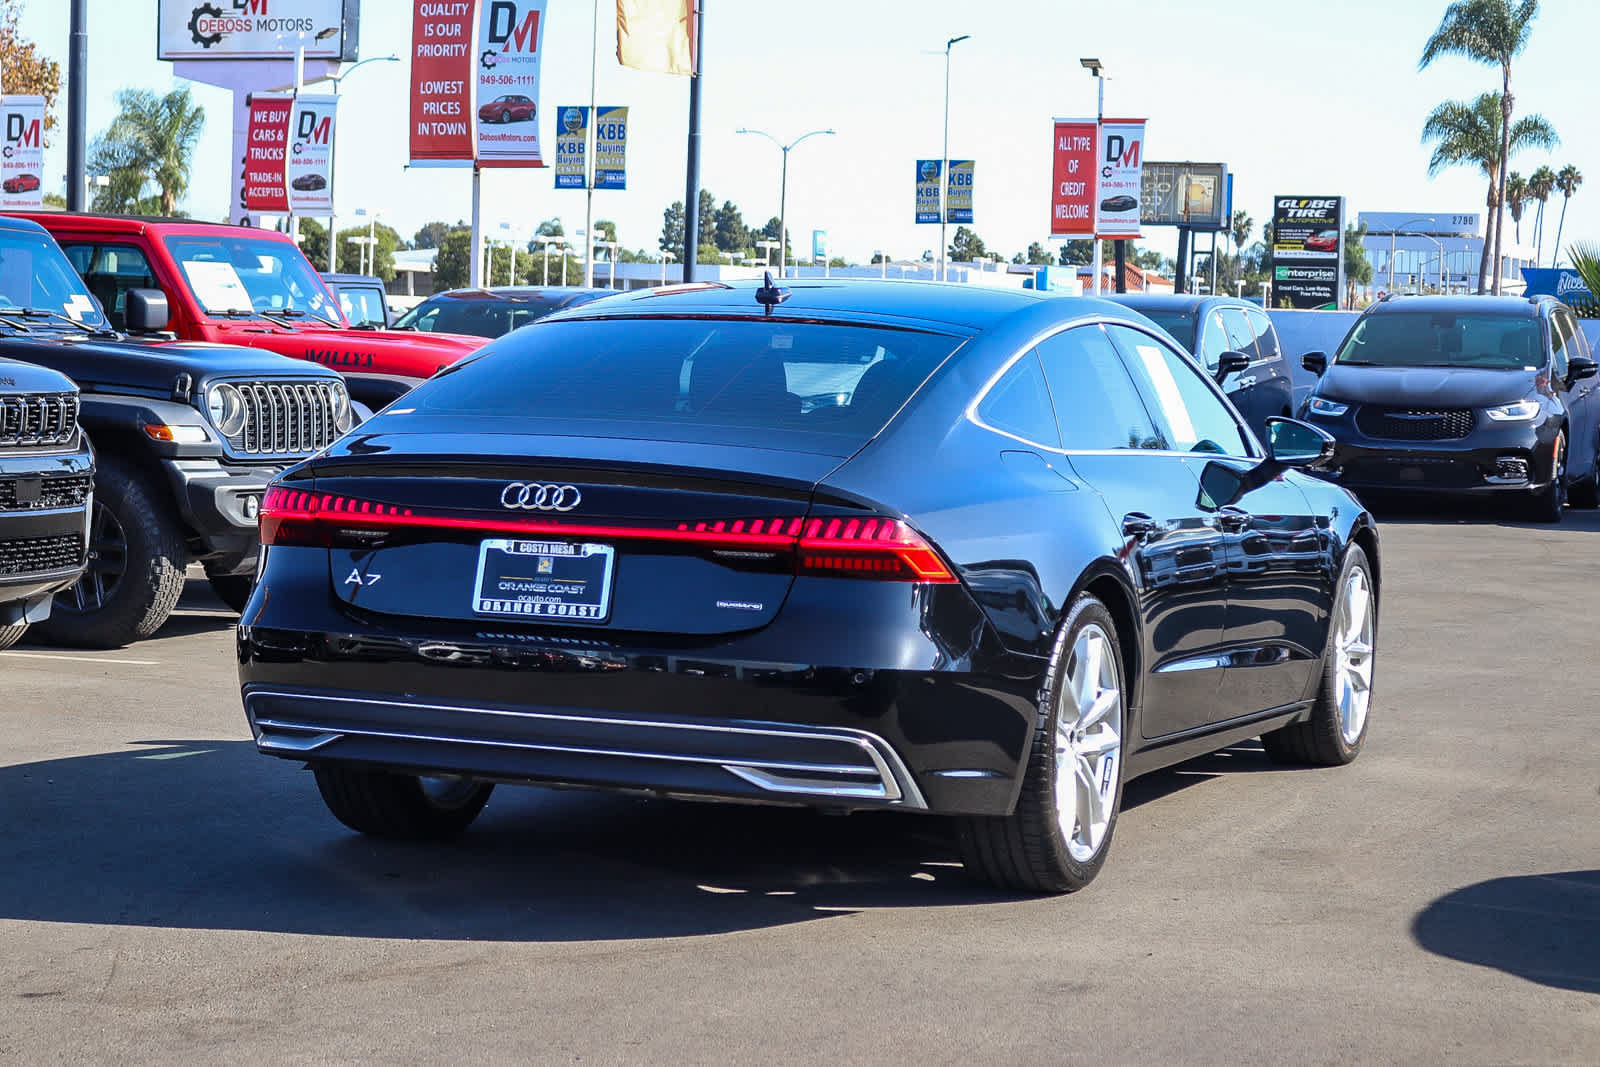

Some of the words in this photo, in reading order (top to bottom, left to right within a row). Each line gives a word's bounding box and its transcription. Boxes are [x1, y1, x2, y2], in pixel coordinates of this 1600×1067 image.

[420, 3, 469, 17] QUALITY
[199, 19, 252, 32] DEBOSS
[256, 18, 313, 31] MOTORS
[424, 24, 434, 37] IS
[436, 24, 461, 37] OUR
[488, 1, 540, 53] DM
[417, 43, 468, 57] PRIORITY
[480, 75, 535, 85] 949-506-1111
[420, 81, 464, 94] LOWEST
[423, 102, 461, 115] PRICES
[253, 111, 268, 122] WE
[270, 111, 288, 123] BUY
[7, 113, 40, 147] DM
[298, 111, 331, 144] DM
[418, 122, 429, 135] IN
[431, 122, 467, 136] TOWN
[597, 124, 626, 140] KBB
[252, 129, 275, 141] CARS
[276, 130, 284, 140] &
[557, 142, 585, 154] KBB
[597, 142, 625, 156] Buying
[1059, 136, 1072, 151] ALL
[1073, 136, 1091, 151] TYPE
[250, 147, 284, 160] TRUCKS
[1106, 135, 1140, 168] DM
[557, 154, 585, 166] Buying
[1068, 159, 1079, 173] OF
[249, 172, 282, 183] TRADE-IN
[949, 173, 973, 186] KBB
[248, 187, 285, 198] ACCEPTED
[917, 188, 940, 197] KBB
[1060, 182, 1086, 196] CREDIT
[1278, 199, 1337, 209] GLOBE
[1055, 204, 1089, 219] WELCOME
[1288, 209, 1328, 218] TIRE
[1278, 269, 1334, 279] enterprise
[305, 349, 376, 367] WILLYS
[519, 543, 548, 554] COSTA
[549, 544, 575, 555] MESA
[344, 567, 382, 586] A7
[498, 582, 547, 593] ORANGE
[547, 583, 586, 595] COAST
[482, 600, 541, 614] ORANGE
[547, 604, 598, 617] COAST
